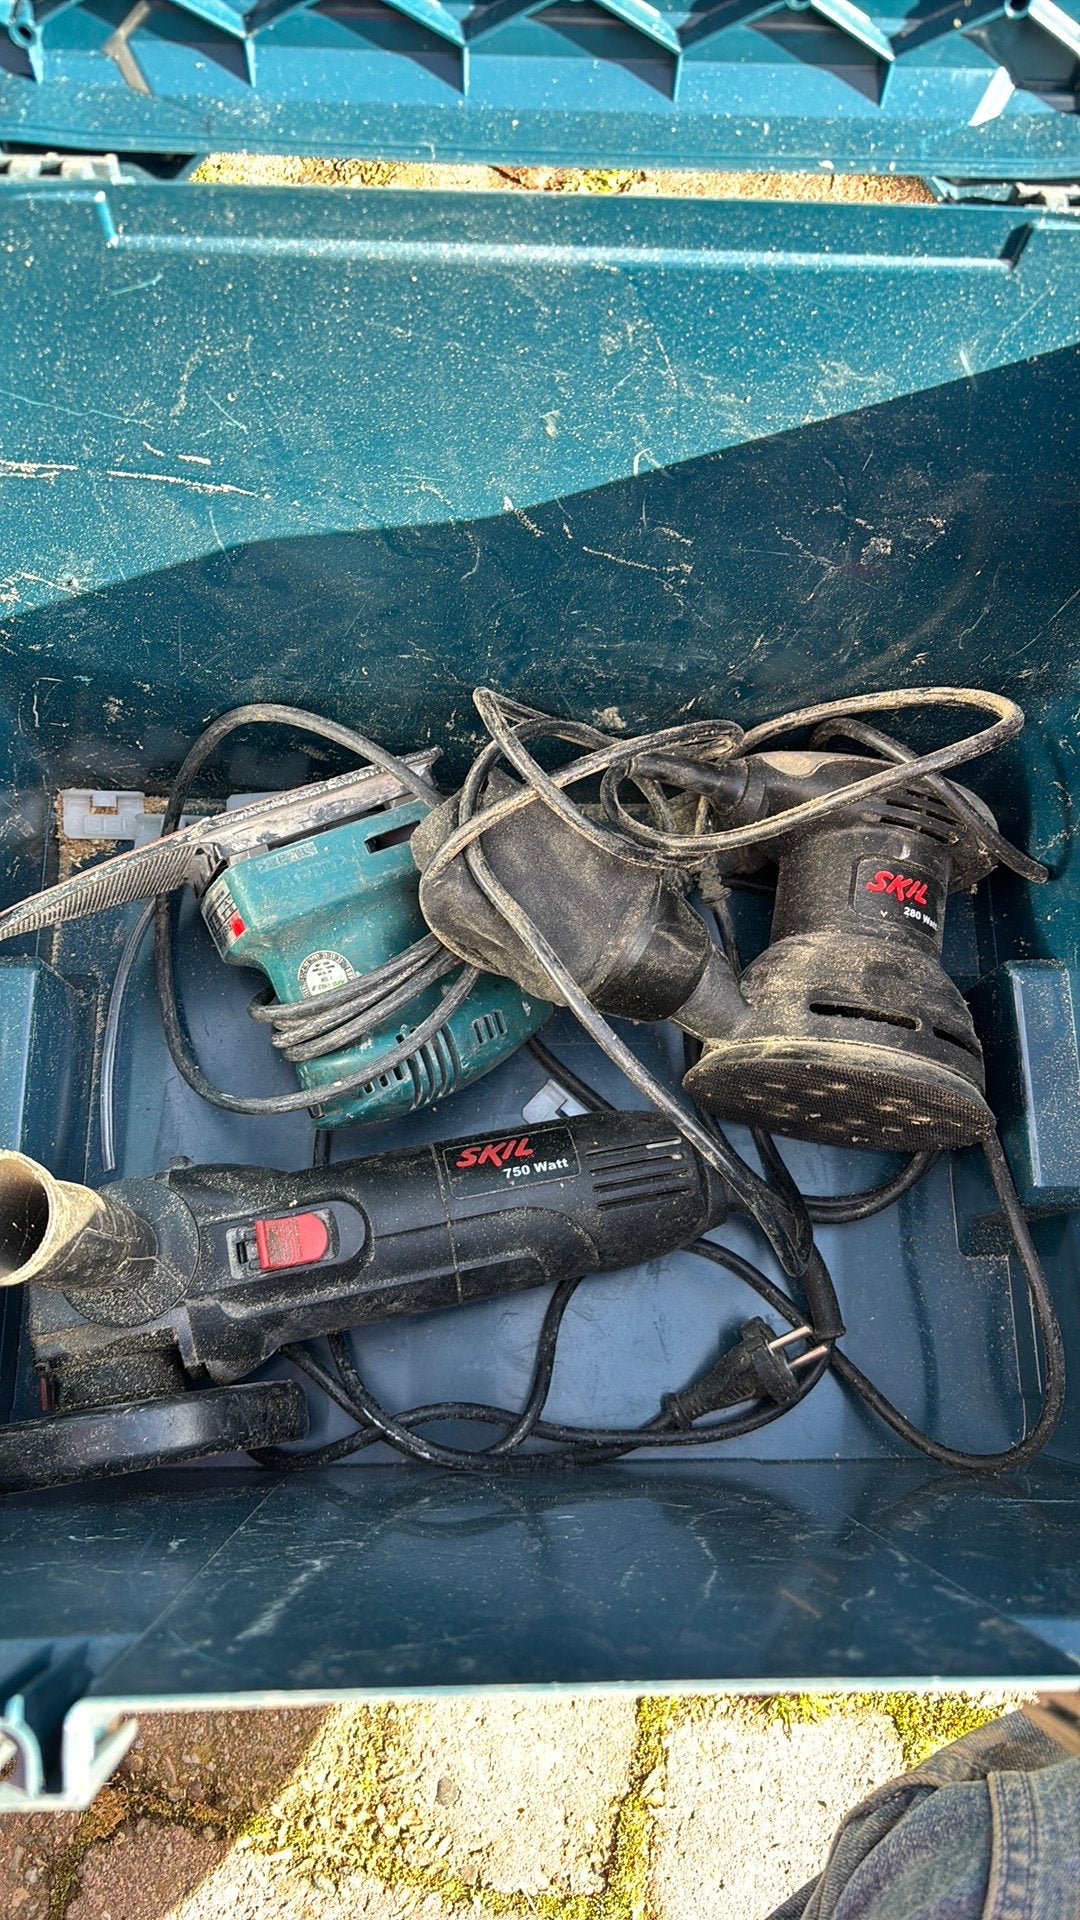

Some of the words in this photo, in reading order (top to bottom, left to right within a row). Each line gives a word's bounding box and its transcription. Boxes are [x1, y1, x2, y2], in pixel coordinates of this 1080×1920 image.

[866, 870, 928, 905] SKIL
[903, 906, 922, 920] 280
[456, 1137, 534, 1168] SKIL
[502, 1165, 531, 1179] 750
[533, 1158, 569, 1173] Watt
